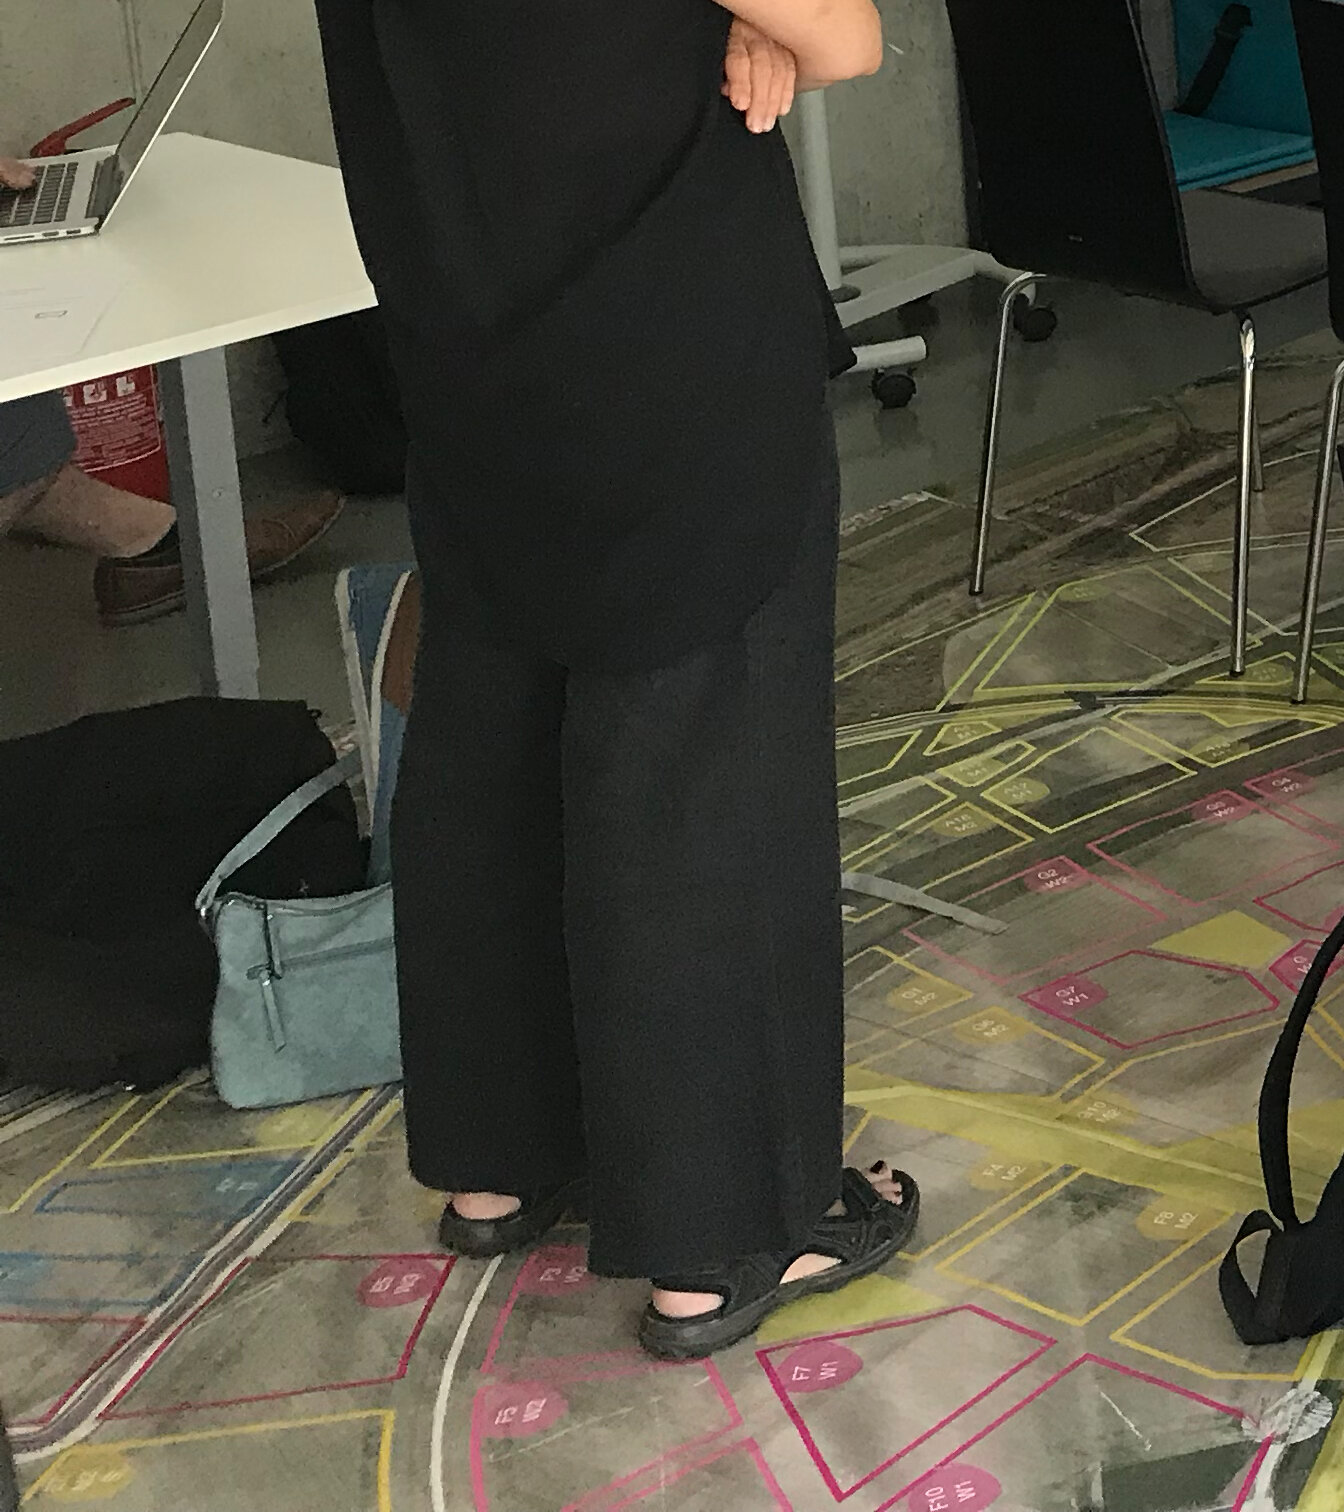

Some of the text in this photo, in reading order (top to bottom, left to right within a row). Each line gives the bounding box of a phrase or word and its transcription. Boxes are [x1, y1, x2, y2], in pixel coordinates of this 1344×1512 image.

[791, 1365, 812, 1381] F7
[818, 1361, 839, 1380] W1
[925, 1486, 949, 1512] F10
[953, 1480, 976, 1503] W1
